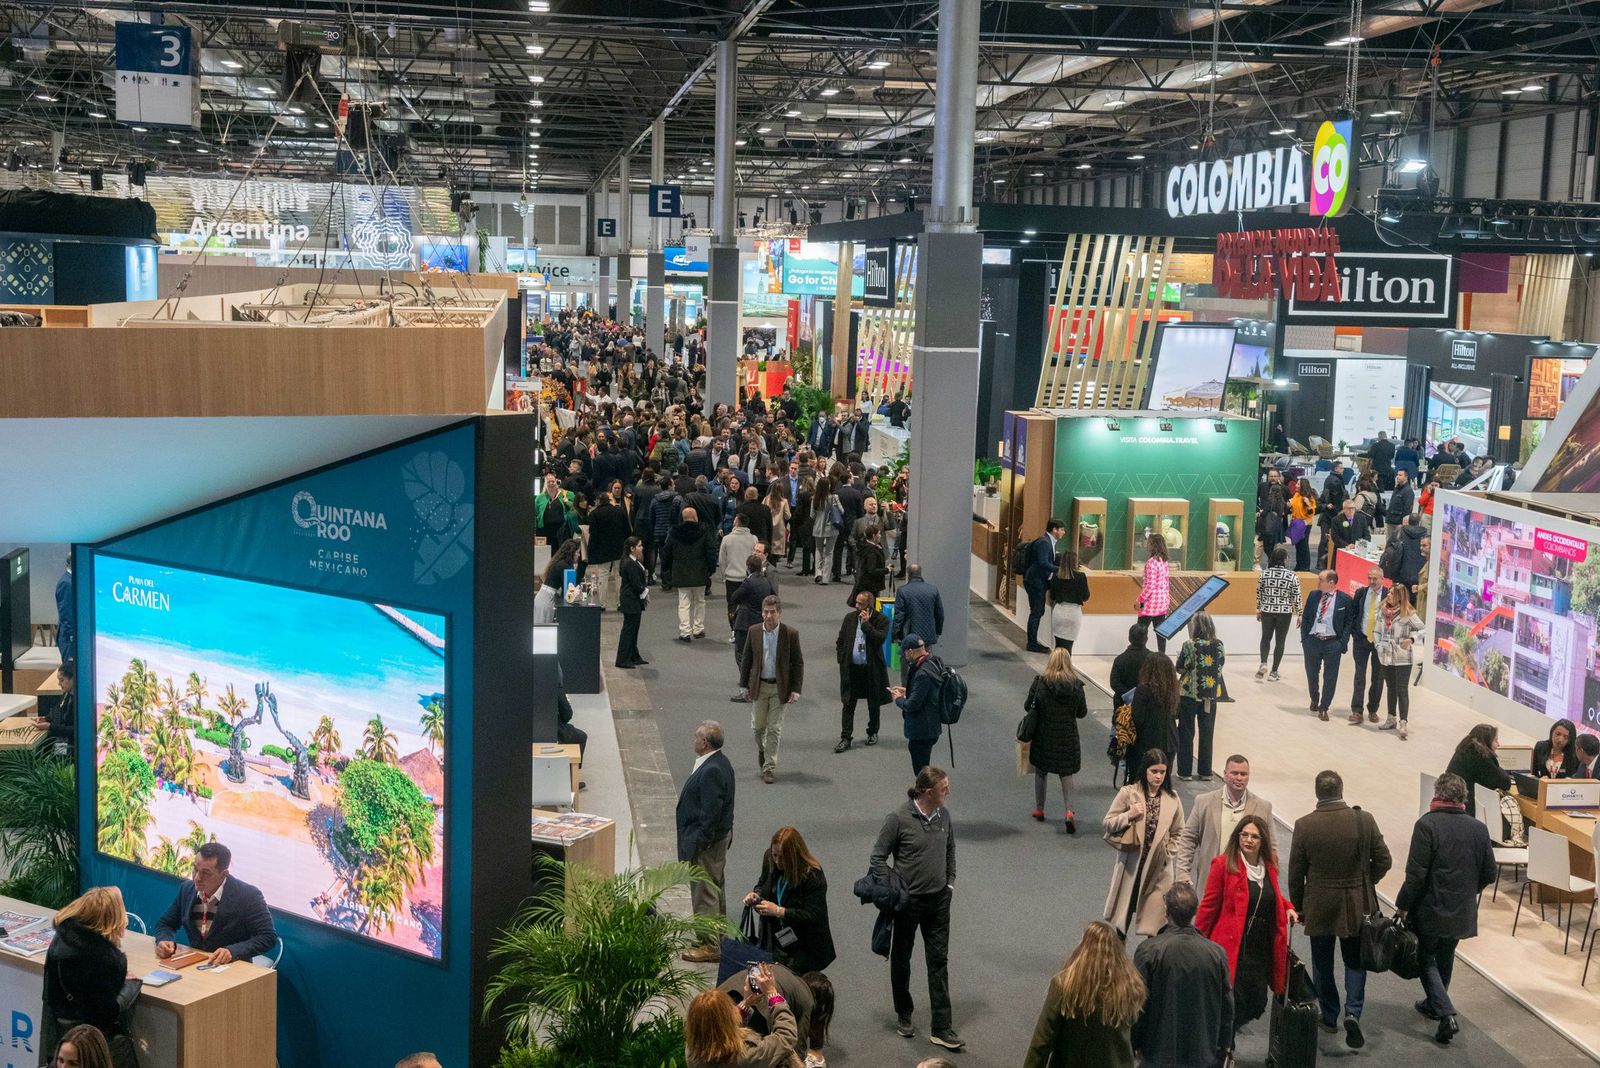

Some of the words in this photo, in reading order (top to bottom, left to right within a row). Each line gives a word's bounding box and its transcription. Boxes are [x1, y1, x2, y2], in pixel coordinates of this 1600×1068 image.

[160, 35, 181, 67] 3
[1167, 145, 1305, 218] COLOMBIA
[1313, 143, 1349, 195] CO
[657, 190, 671, 213] E
[190, 216, 310, 246] Argentina
[602, 222, 611, 235] E
[788, 274, 804, 285] Go
[805, 275, 819, 286] for
[866, 259, 886, 288] Hilton
[1279, 255, 1342, 303] VIDA
[1333, 267, 1436, 305] ilton
[1454, 343, 1475, 358] Hilton
[1301, 365, 1328, 374] Hilton
[291, 489, 388, 530] QUINTANA
[317, 522, 351, 541] ROO
[1536, 531, 1553, 541] ANDES
[1552, 535, 1586, 551] OCCIDENTALES
[309, 560, 368, 578] MEXICANO
[317, 549, 359, 564] CARIBE
[112, 581, 170, 612] CARMEN
